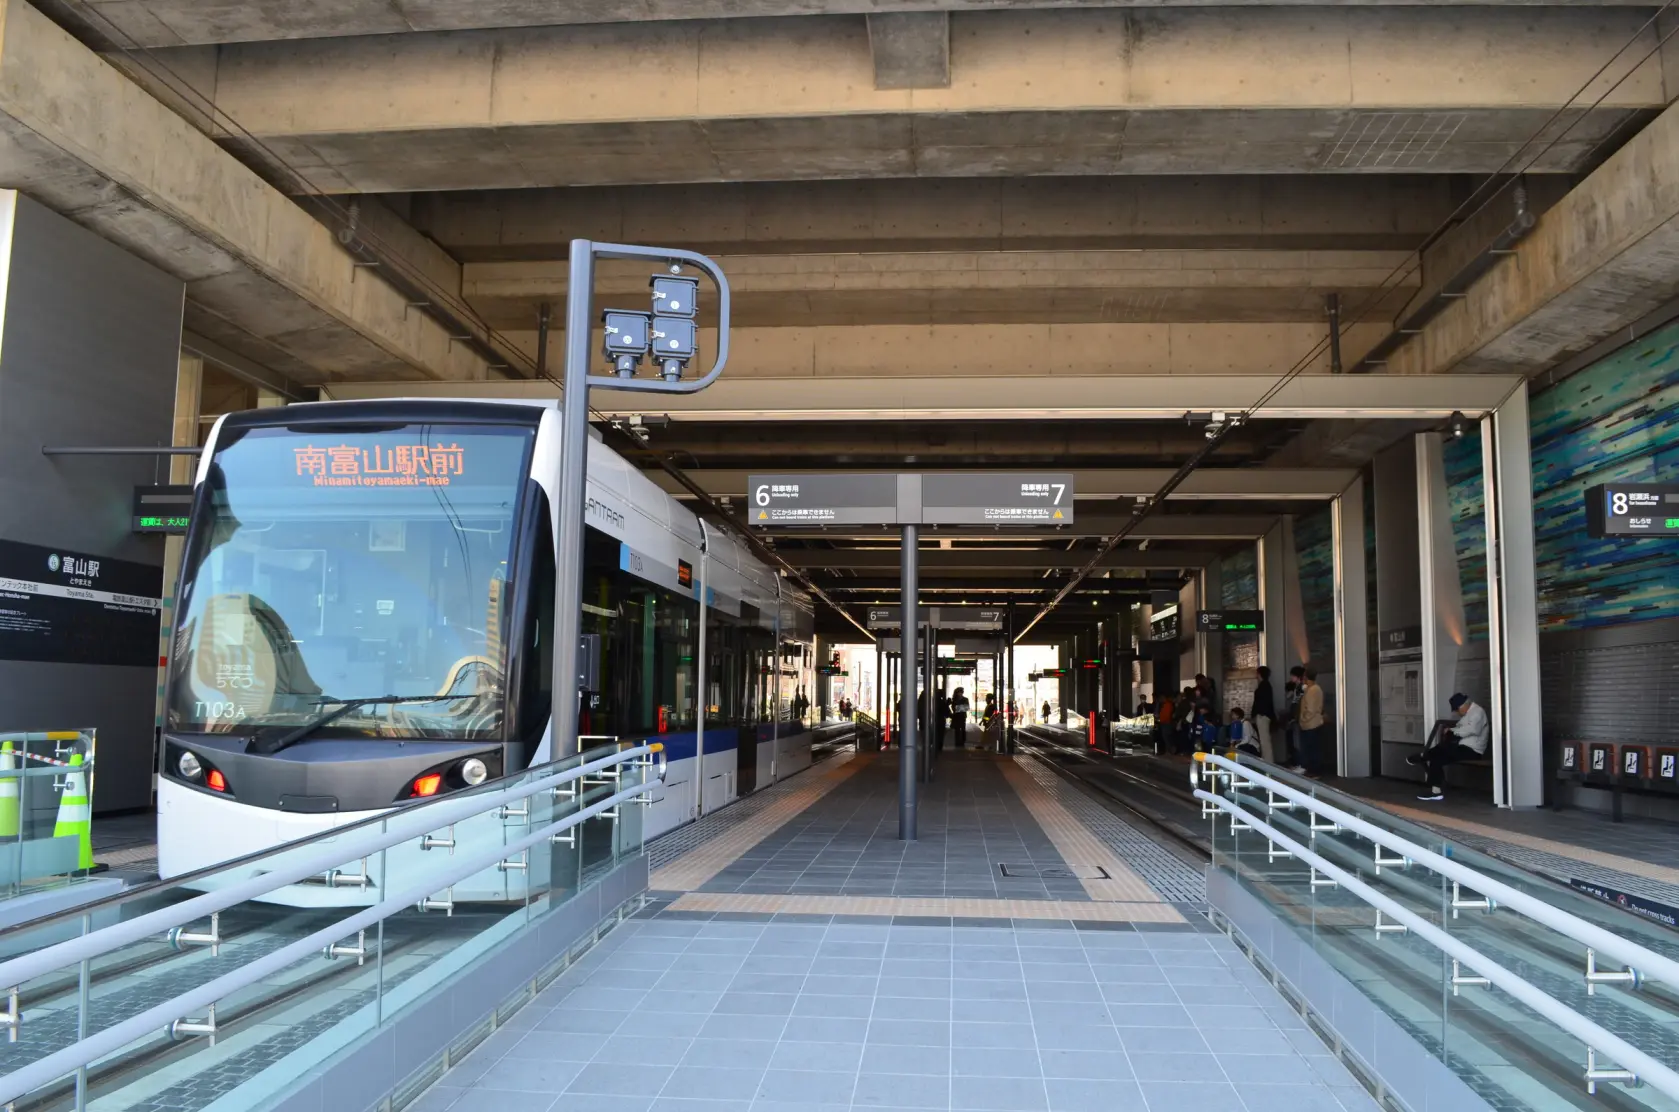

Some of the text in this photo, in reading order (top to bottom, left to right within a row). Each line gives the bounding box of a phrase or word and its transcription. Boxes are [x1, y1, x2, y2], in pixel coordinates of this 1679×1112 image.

[293, 444, 464, 475] 南富山駅前
[313, 474, 450, 487] Minamitoyamaeki-mae
[756, 484, 770, 506] 6
[1051, 483, 1065, 505] 7
[1612, 493, 1628, 514] 8
[63, 556, 100, 577] 富山駅
[69, 577, 92, 587] とやまえき
[66, 589, 86, 598] Toyama
[870, 611, 877, 620] 6
[993, 611, 1000, 621] 7
[1202, 614, 1209, 623] 8
[215, 676, 253, 689] ちてつ
